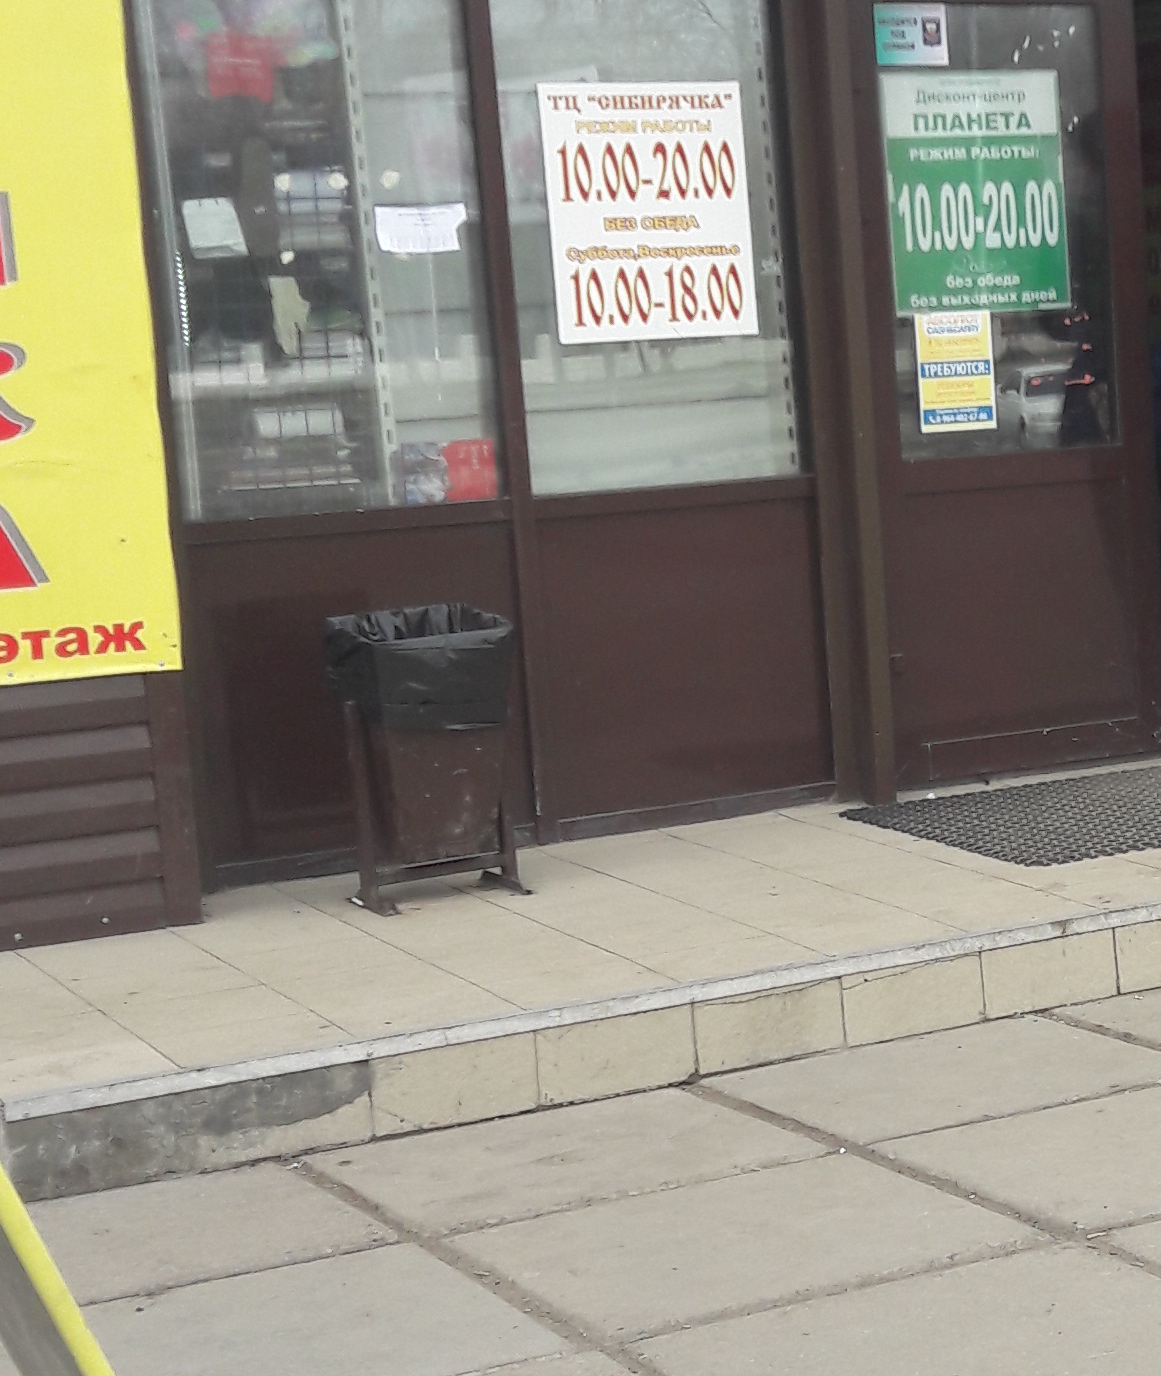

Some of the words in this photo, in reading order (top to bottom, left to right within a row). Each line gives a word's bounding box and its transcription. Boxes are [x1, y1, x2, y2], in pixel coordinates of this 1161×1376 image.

[547, 95, 581, 113] ТЦ
[913, 110, 1032, 132] ПЛАНЕТА
[909, 147, 967, 162] РЕЖИМ
[971, 144, 1040, 160] РАБОТЫ:
[557, 139, 736, 203] 10.00-20.00
[898, 178, 1060, 254] 10.00-20.00
[946, 274, 974, 288] без
[977, 272, 1021, 288] обеда
[570, 263, 743, 328] 10.00-18.00
[910, 293, 937, 308] без
[941, 291, 1018, 307] выходных
[1022, 287, 1057, 305] дней
[924, 361, 989, 378] ТРЕБУЮТСЯ:
